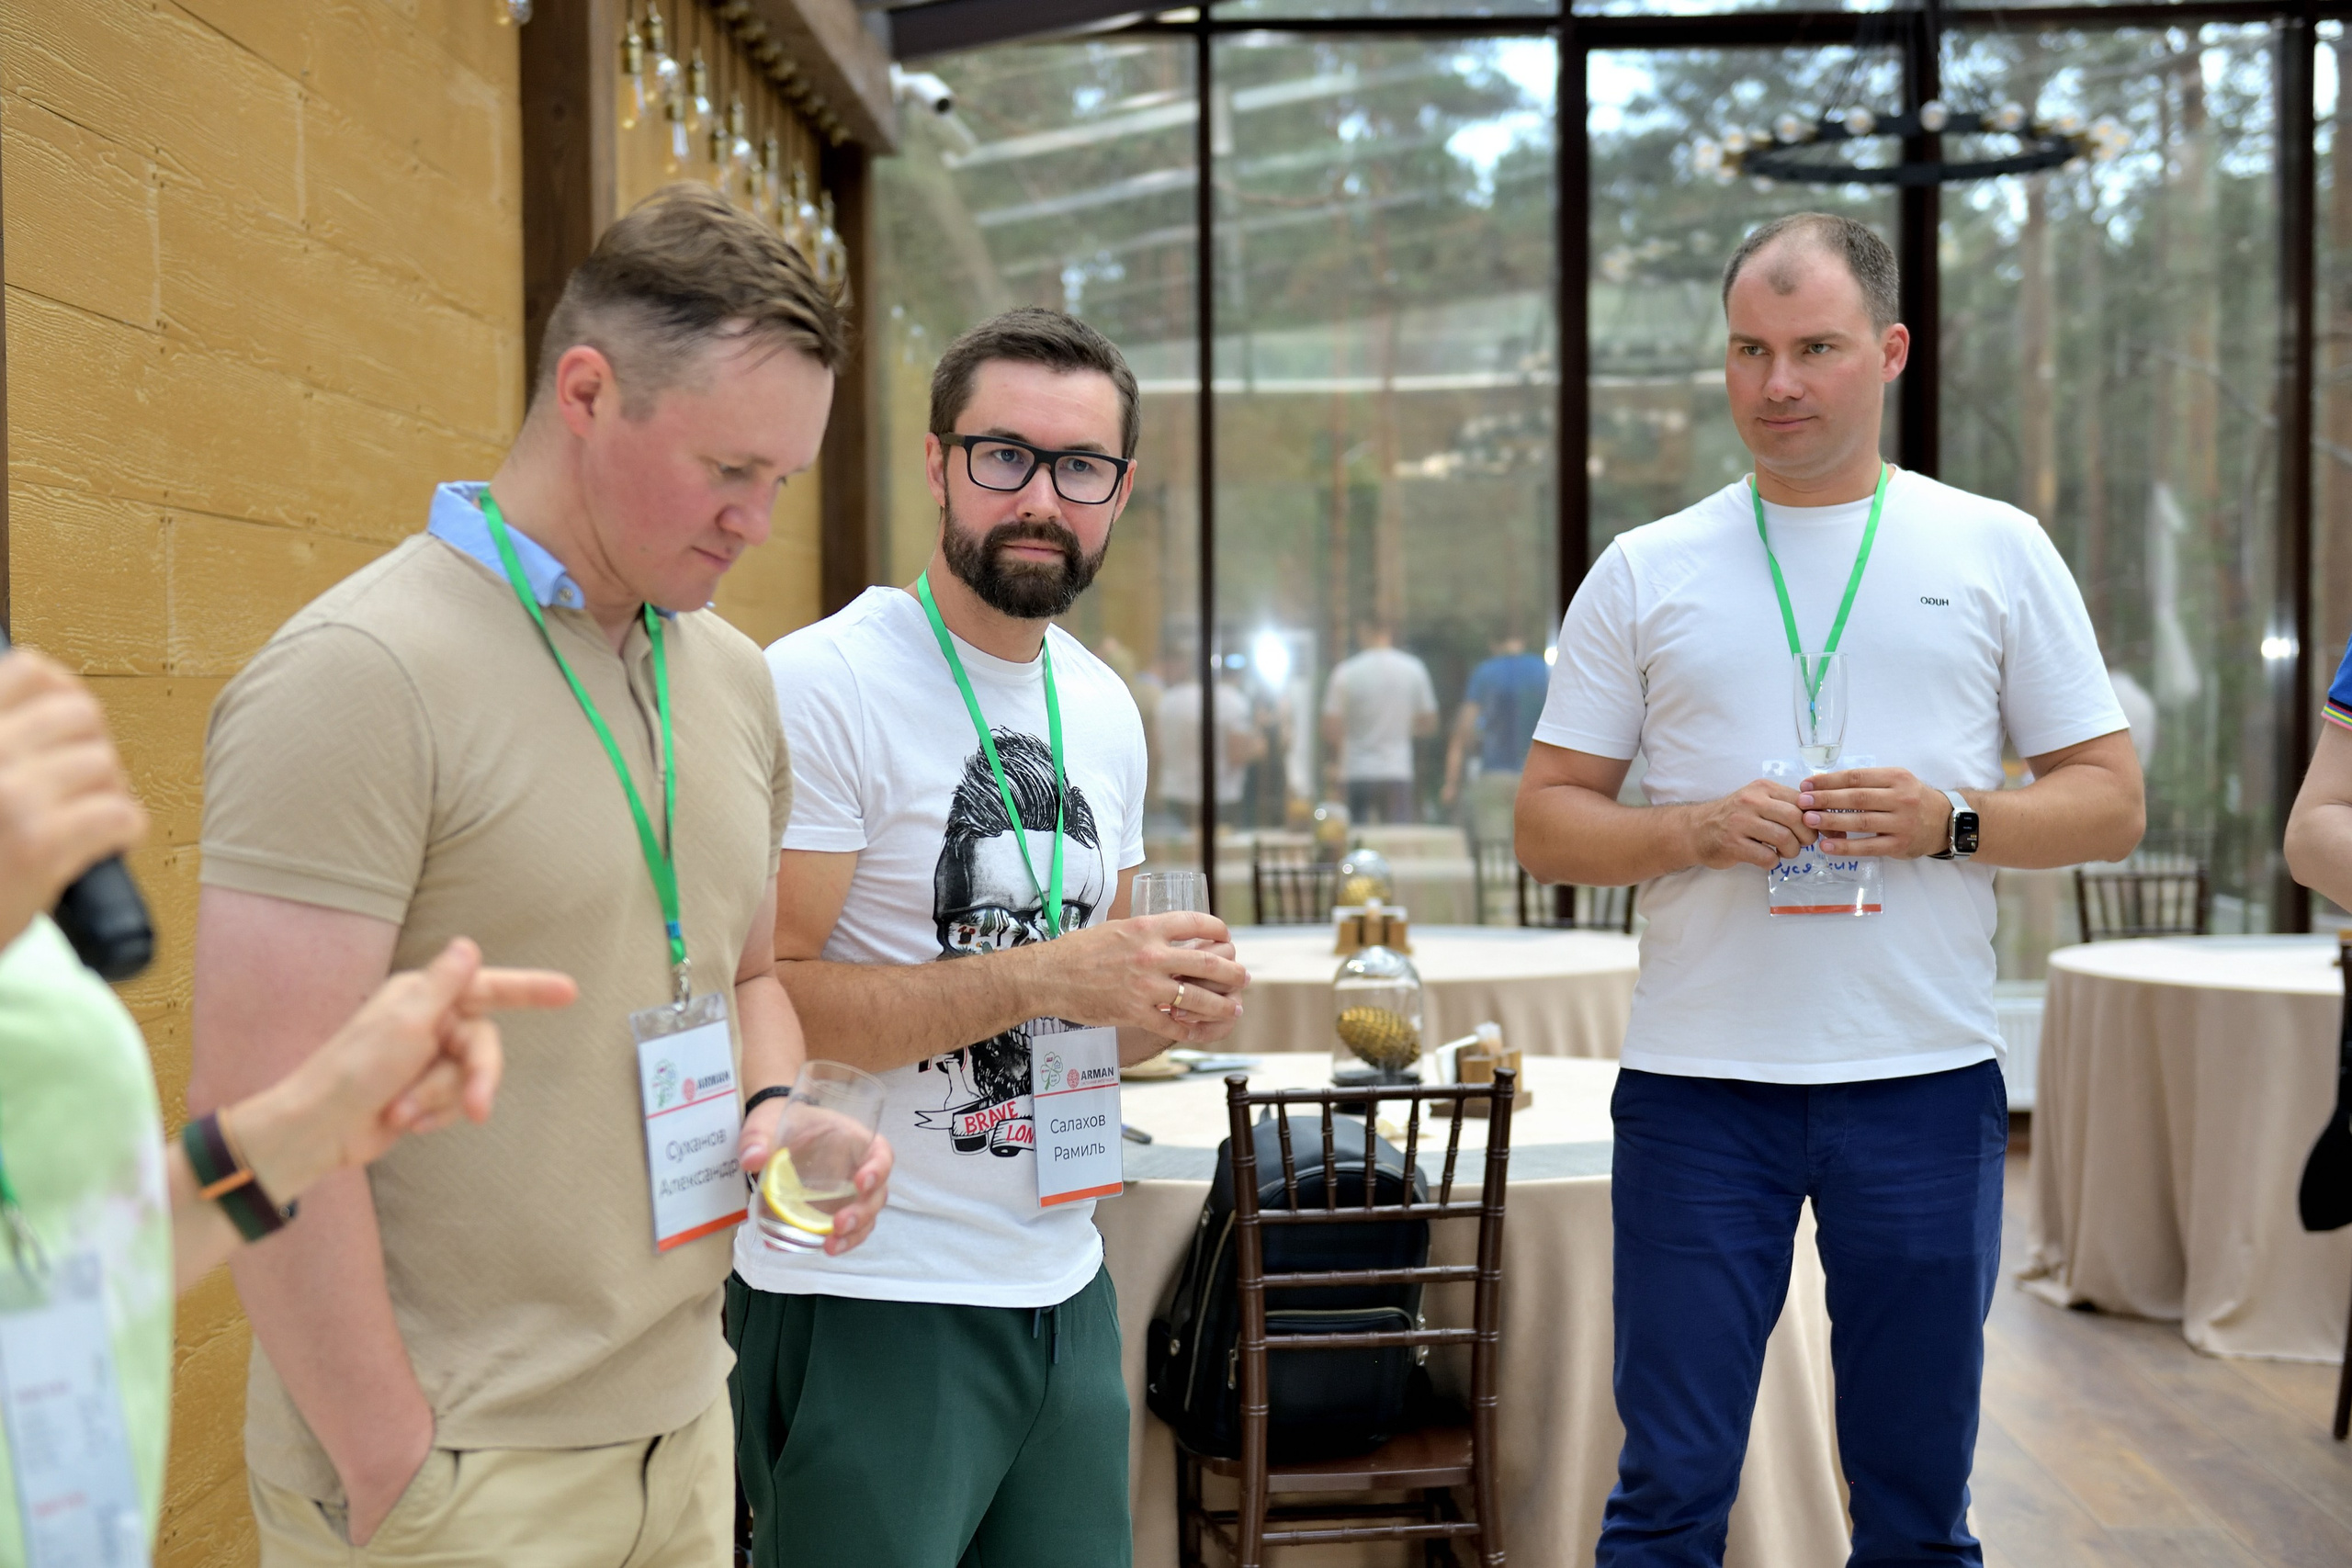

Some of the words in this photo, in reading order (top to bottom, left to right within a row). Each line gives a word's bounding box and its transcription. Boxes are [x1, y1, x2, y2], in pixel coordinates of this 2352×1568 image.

[1081, 1066, 1114, 1080] ARMAN
[965, 1100, 1018, 1134] BRAVE
[1050, 1114, 1106, 1134] Салахов
[666, 1129, 727, 1162] Суханов
[1054, 1143, 1105, 1162] Рамиль
[659, 1158, 740, 1198] Александр
